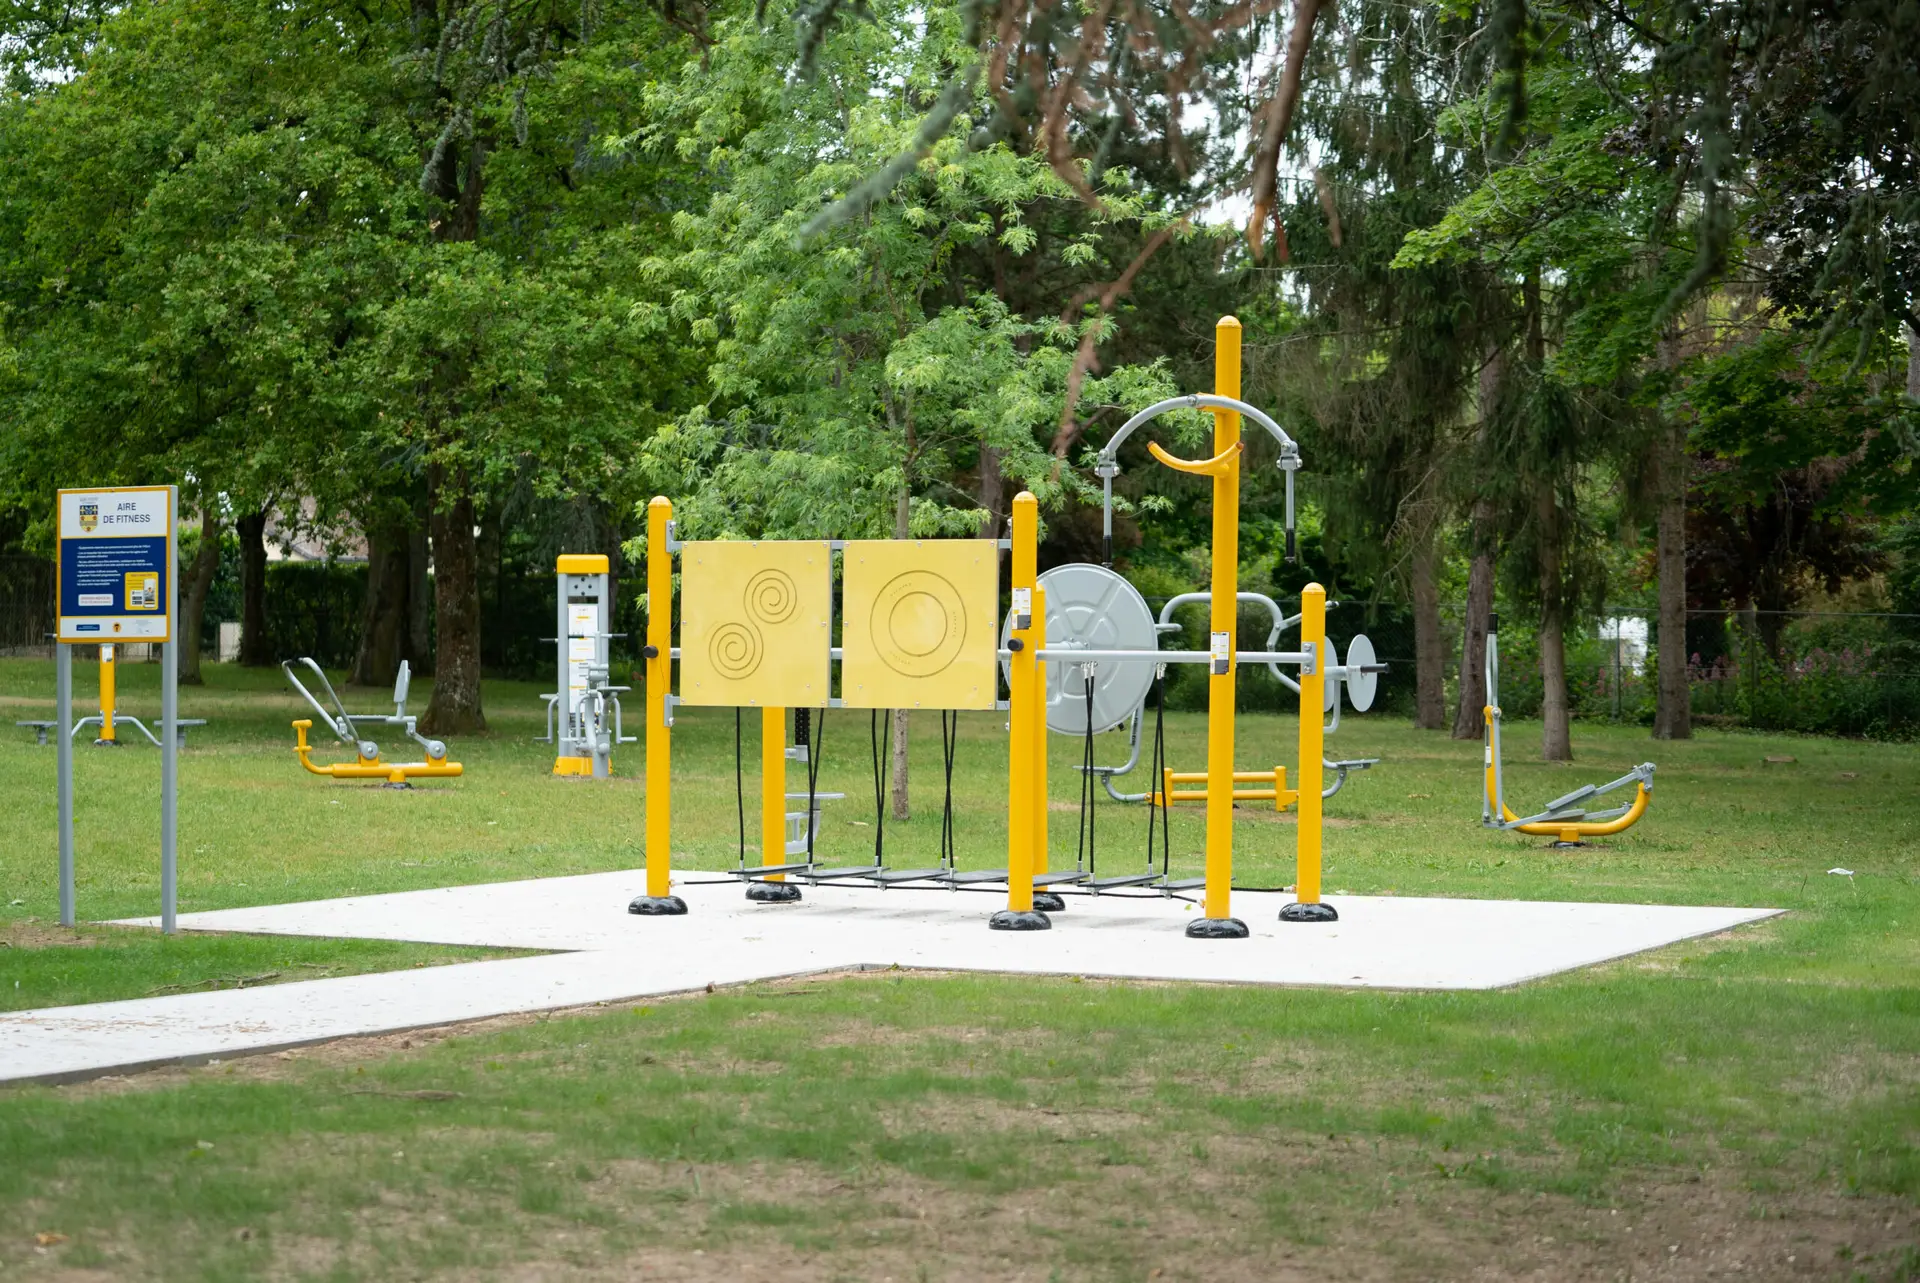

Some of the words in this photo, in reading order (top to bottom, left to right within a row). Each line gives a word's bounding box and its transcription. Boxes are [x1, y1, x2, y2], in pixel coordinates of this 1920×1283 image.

[117, 502, 137, 511] AIRE
[103, 515, 114, 524] DE
[116, 514, 151, 523] FITNESS
